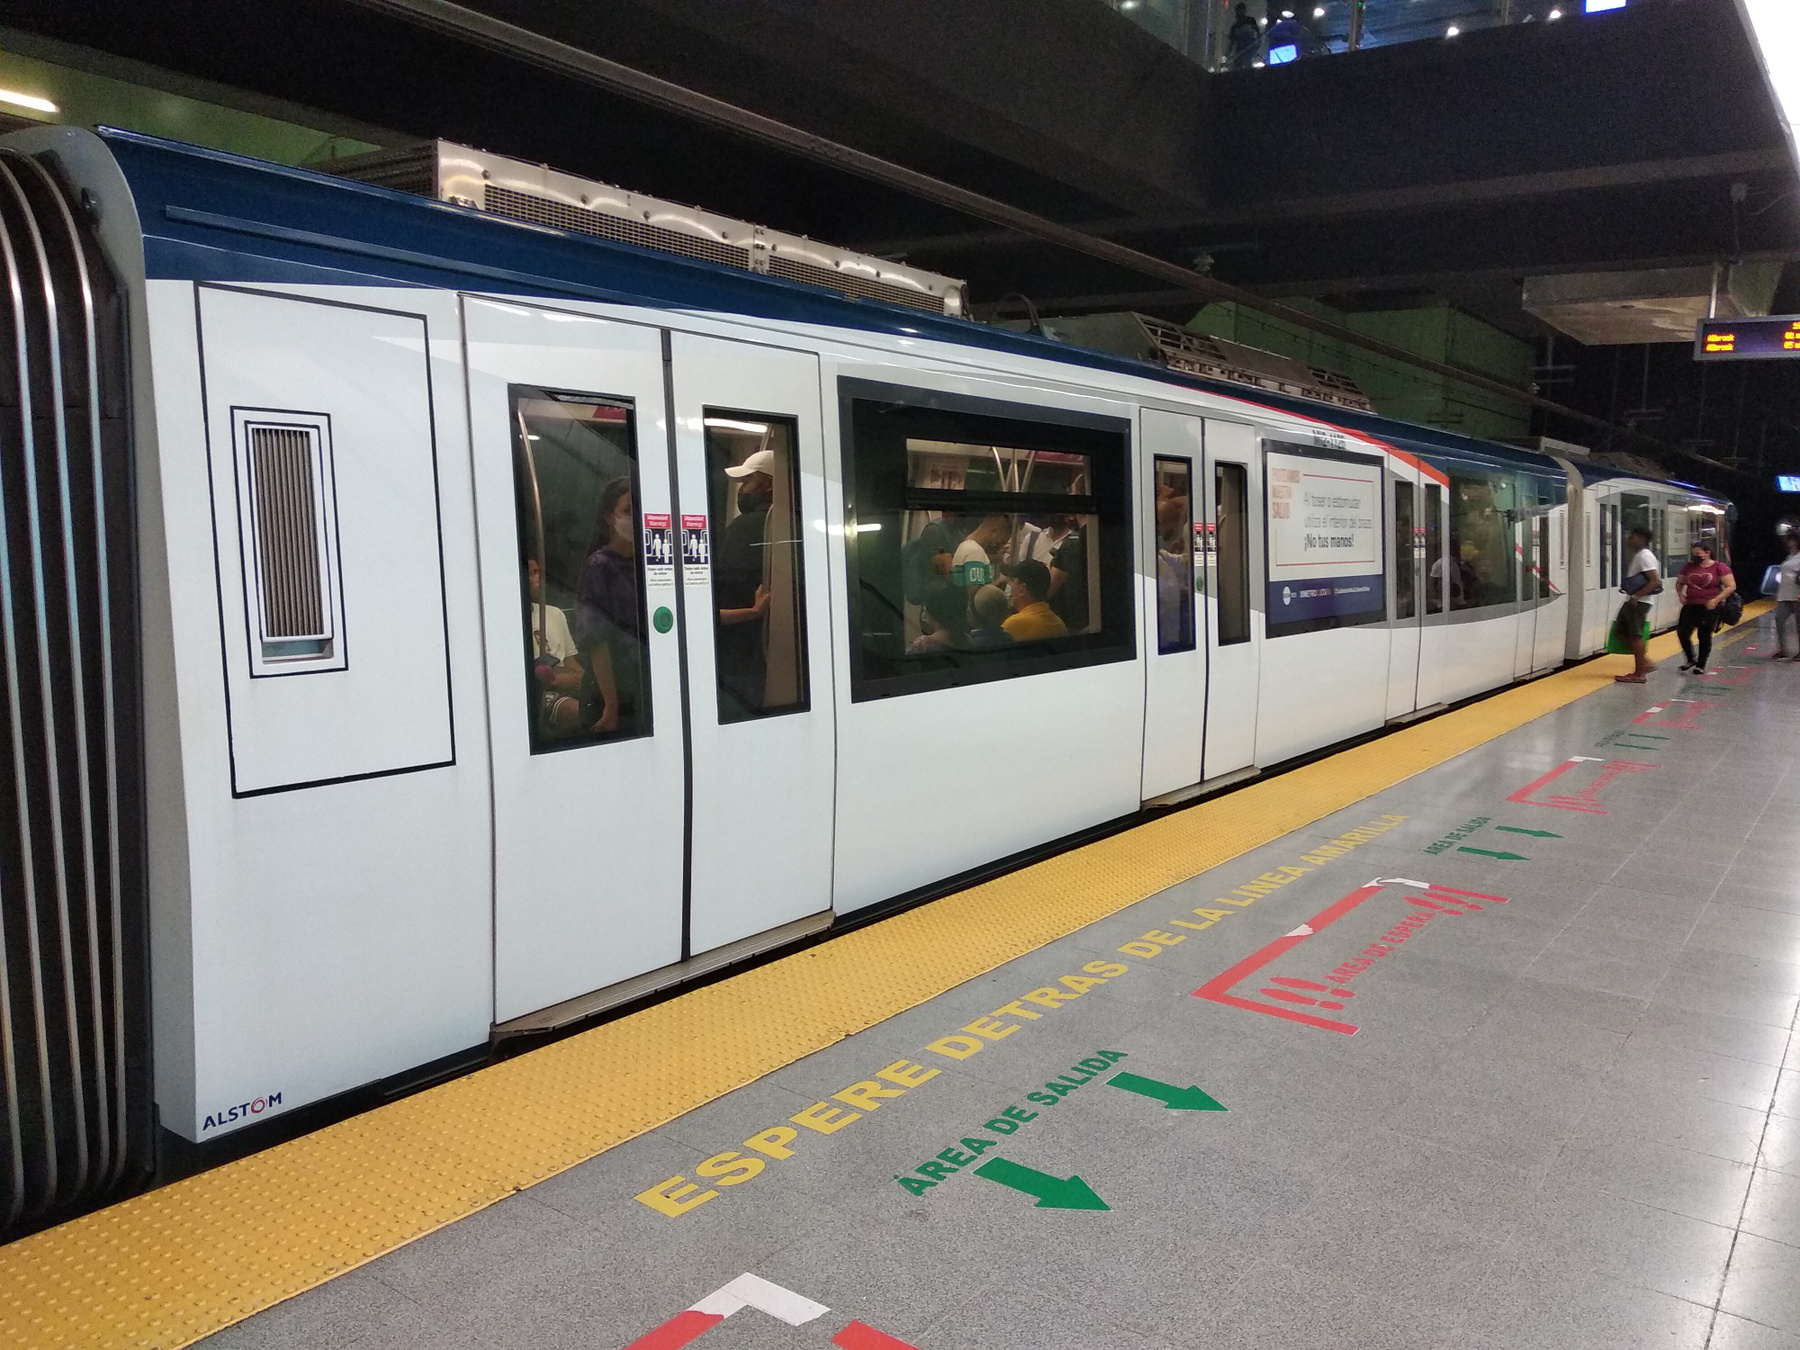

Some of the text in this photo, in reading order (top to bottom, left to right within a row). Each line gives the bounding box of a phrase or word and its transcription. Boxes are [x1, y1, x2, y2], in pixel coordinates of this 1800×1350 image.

[1304, 533, 1355, 552] ¡No tus manos!
[1444, 832, 1468, 841] DE
[1361, 943, 1396, 958] DE
[1379, 911, 1436, 944] ESPERA
[634, 814, 1410, 1218] ESPERE DETRAS DE LA LINEA AMARILLA
[202, 1092, 282, 1131] ALSTOM
[893, 1050, 1128, 1197] ÁREA DE SALIDA
